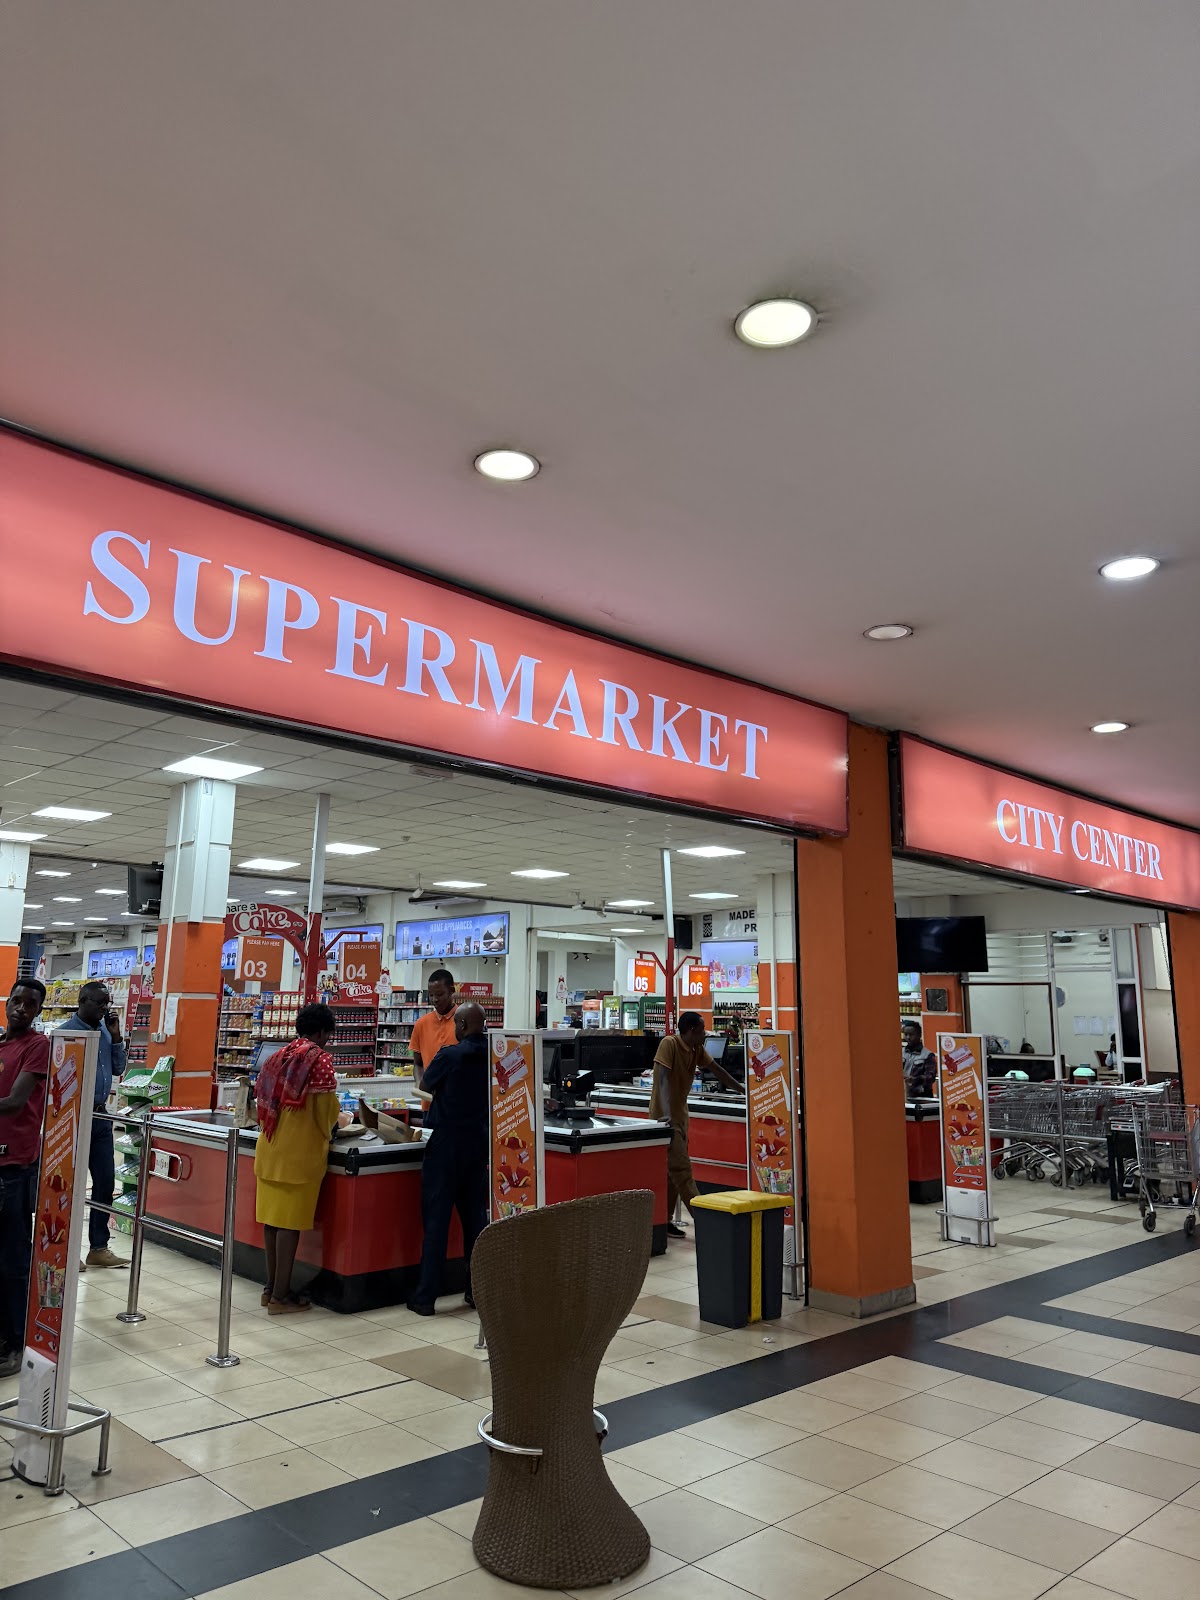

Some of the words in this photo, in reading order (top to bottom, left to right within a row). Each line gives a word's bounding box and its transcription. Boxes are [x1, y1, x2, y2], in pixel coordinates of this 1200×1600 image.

[83, 530, 768, 780] SUPERMARKET
[996, 799, 1064, 855] CITY
[1071, 820, 1164, 880] CENTER
[233, 908, 287, 932] Coke
[729, 909, 755, 921] MADE
[430, 922, 444, 932] HOME
[444, 920, 473, 931] APPLIANCES
[244, 960, 267, 978] 03
[346, 964, 367, 980] 04
[346, 984, 373, 997] Coke
[635, 976, 648, 991] 05
[690, 981, 703, 995] 06
